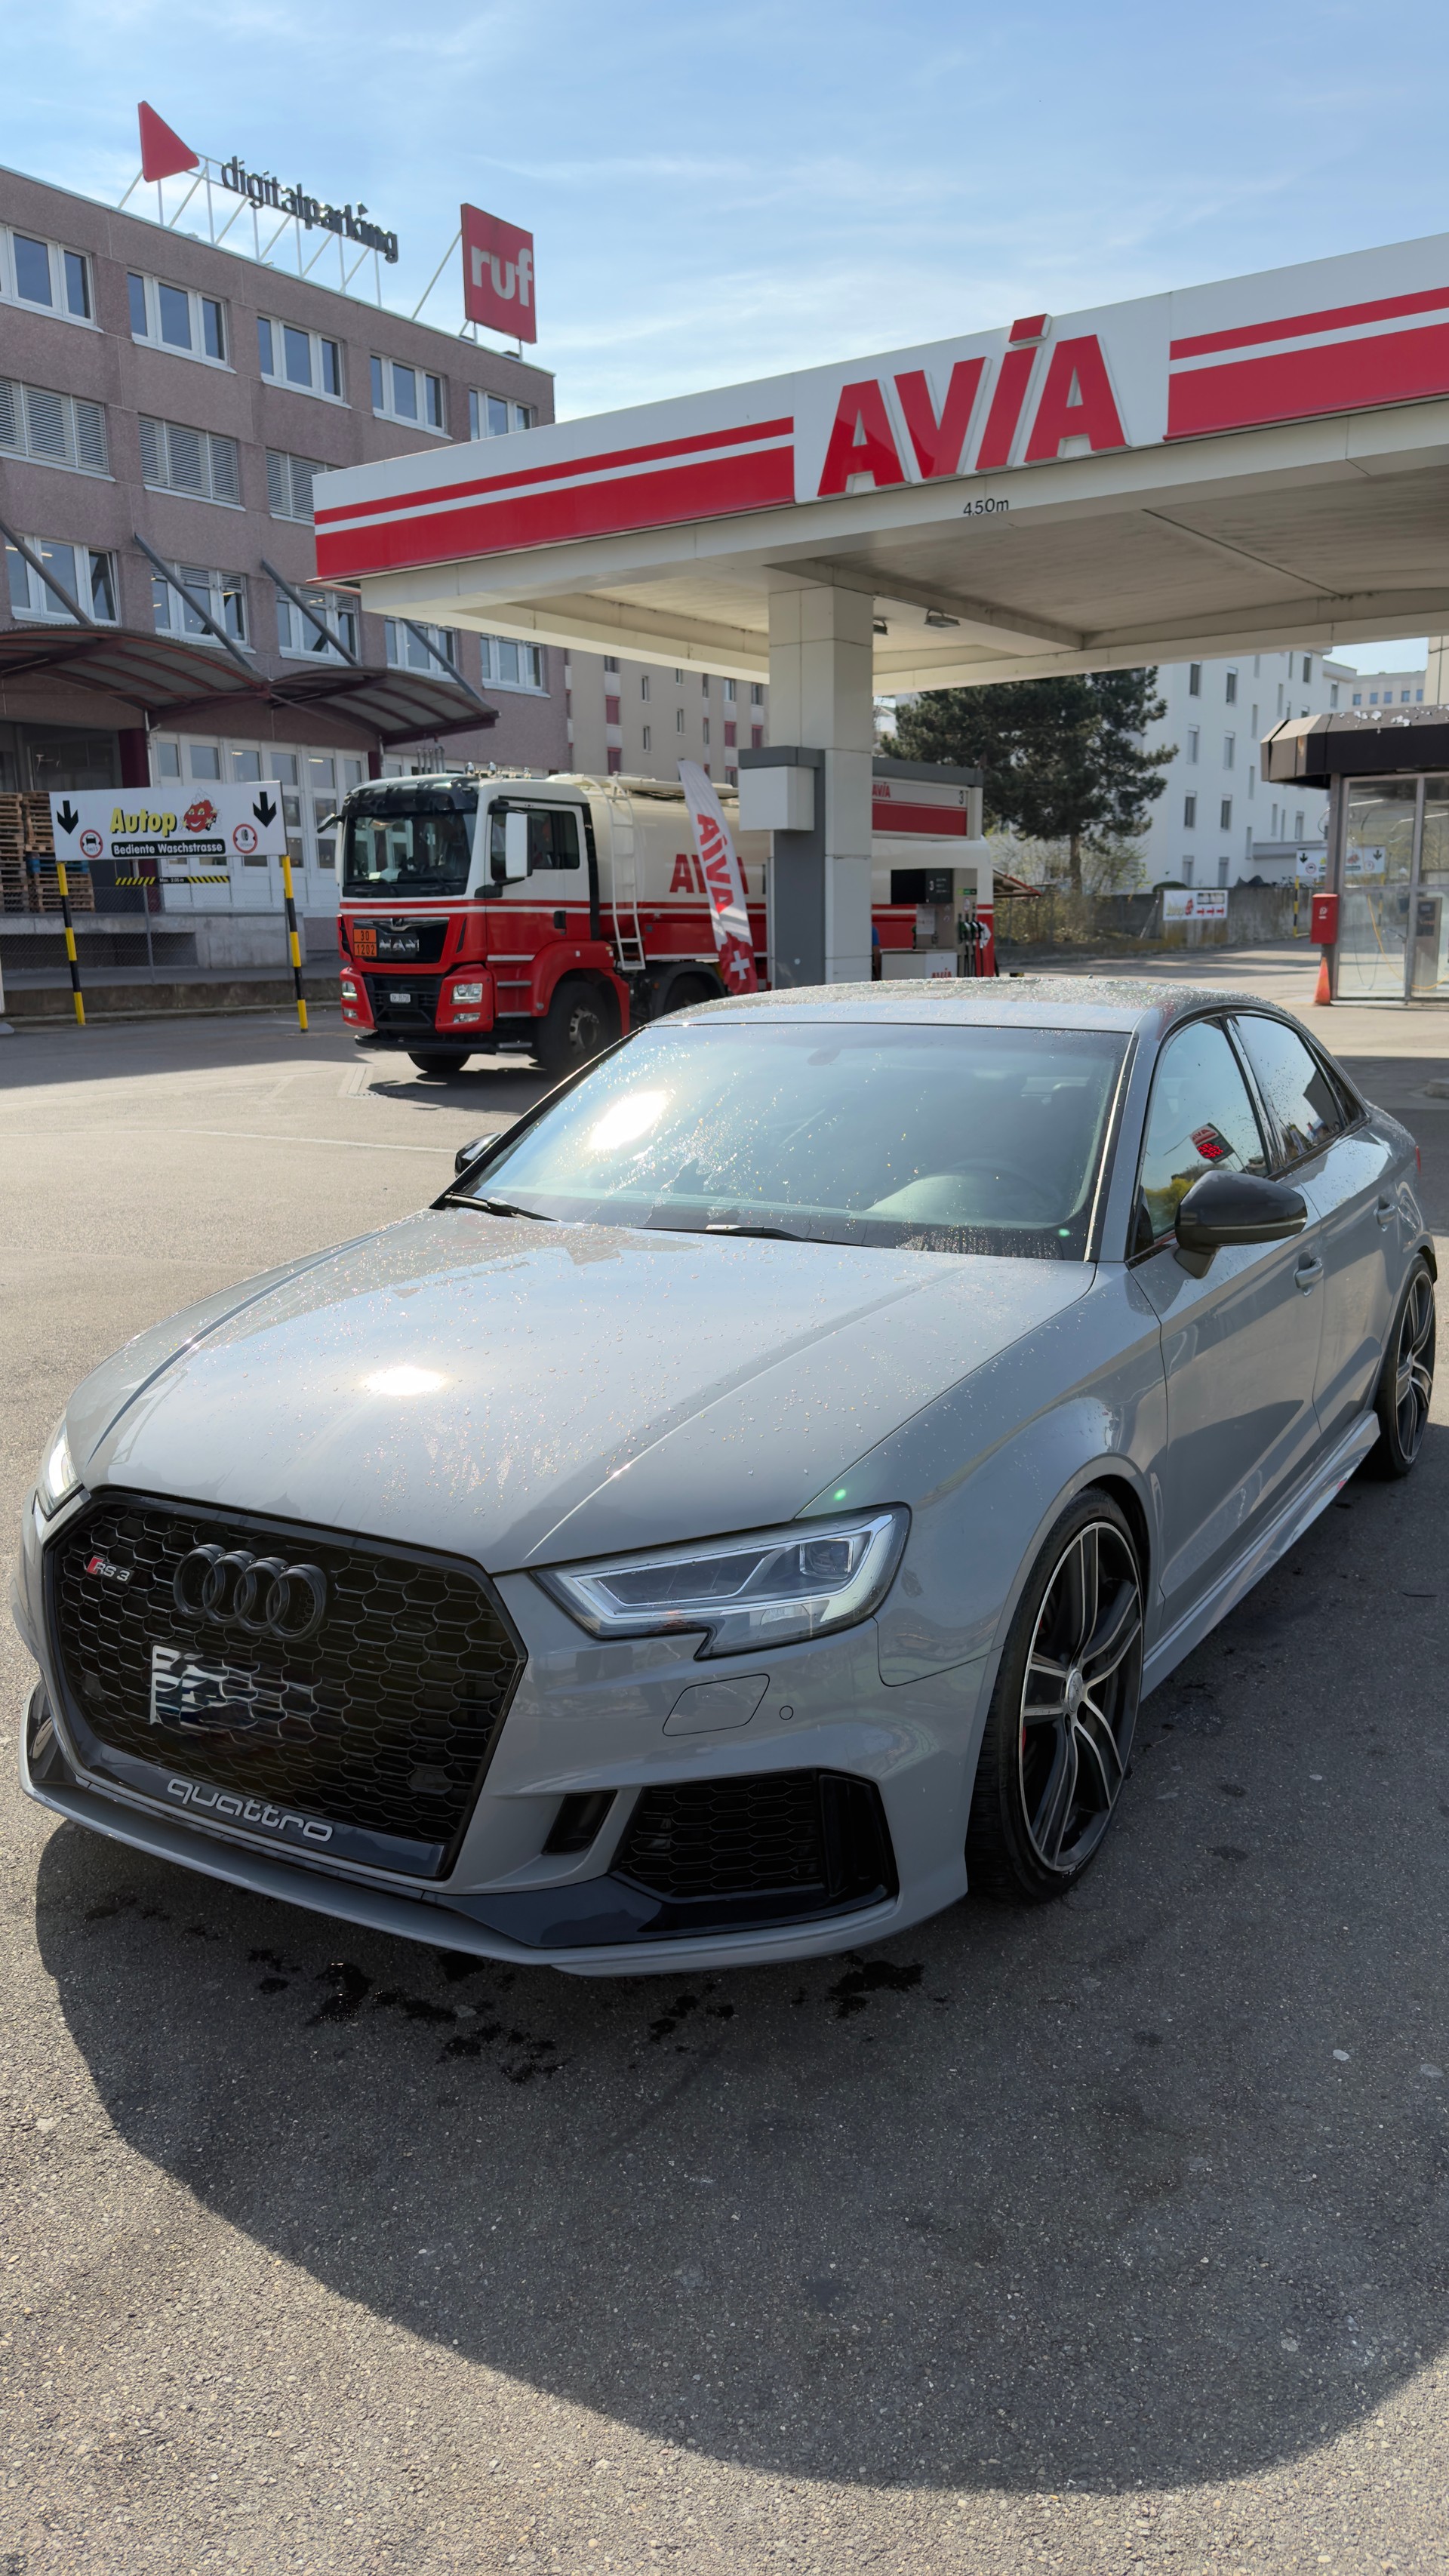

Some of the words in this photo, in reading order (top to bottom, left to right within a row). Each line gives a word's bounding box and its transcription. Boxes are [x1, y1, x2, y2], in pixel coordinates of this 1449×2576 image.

[221, 155, 398, 263] digitalparking
[471, 247, 533, 307] ruf
[959, 790, 964, 805] 3
[110, 808, 177, 838] Autop
[113, 844, 155, 855] Bediente
[158, 841, 223, 854] Waschstrasse
[361, 931, 369, 941] 30
[357, 943, 375, 955] 1202
[380, 939, 420, 952] MAN
[93, 1562, 117, 1577] RS
[116, 1570, 131, 1582] 3
[167, 1778, 333, 1842] quattro
